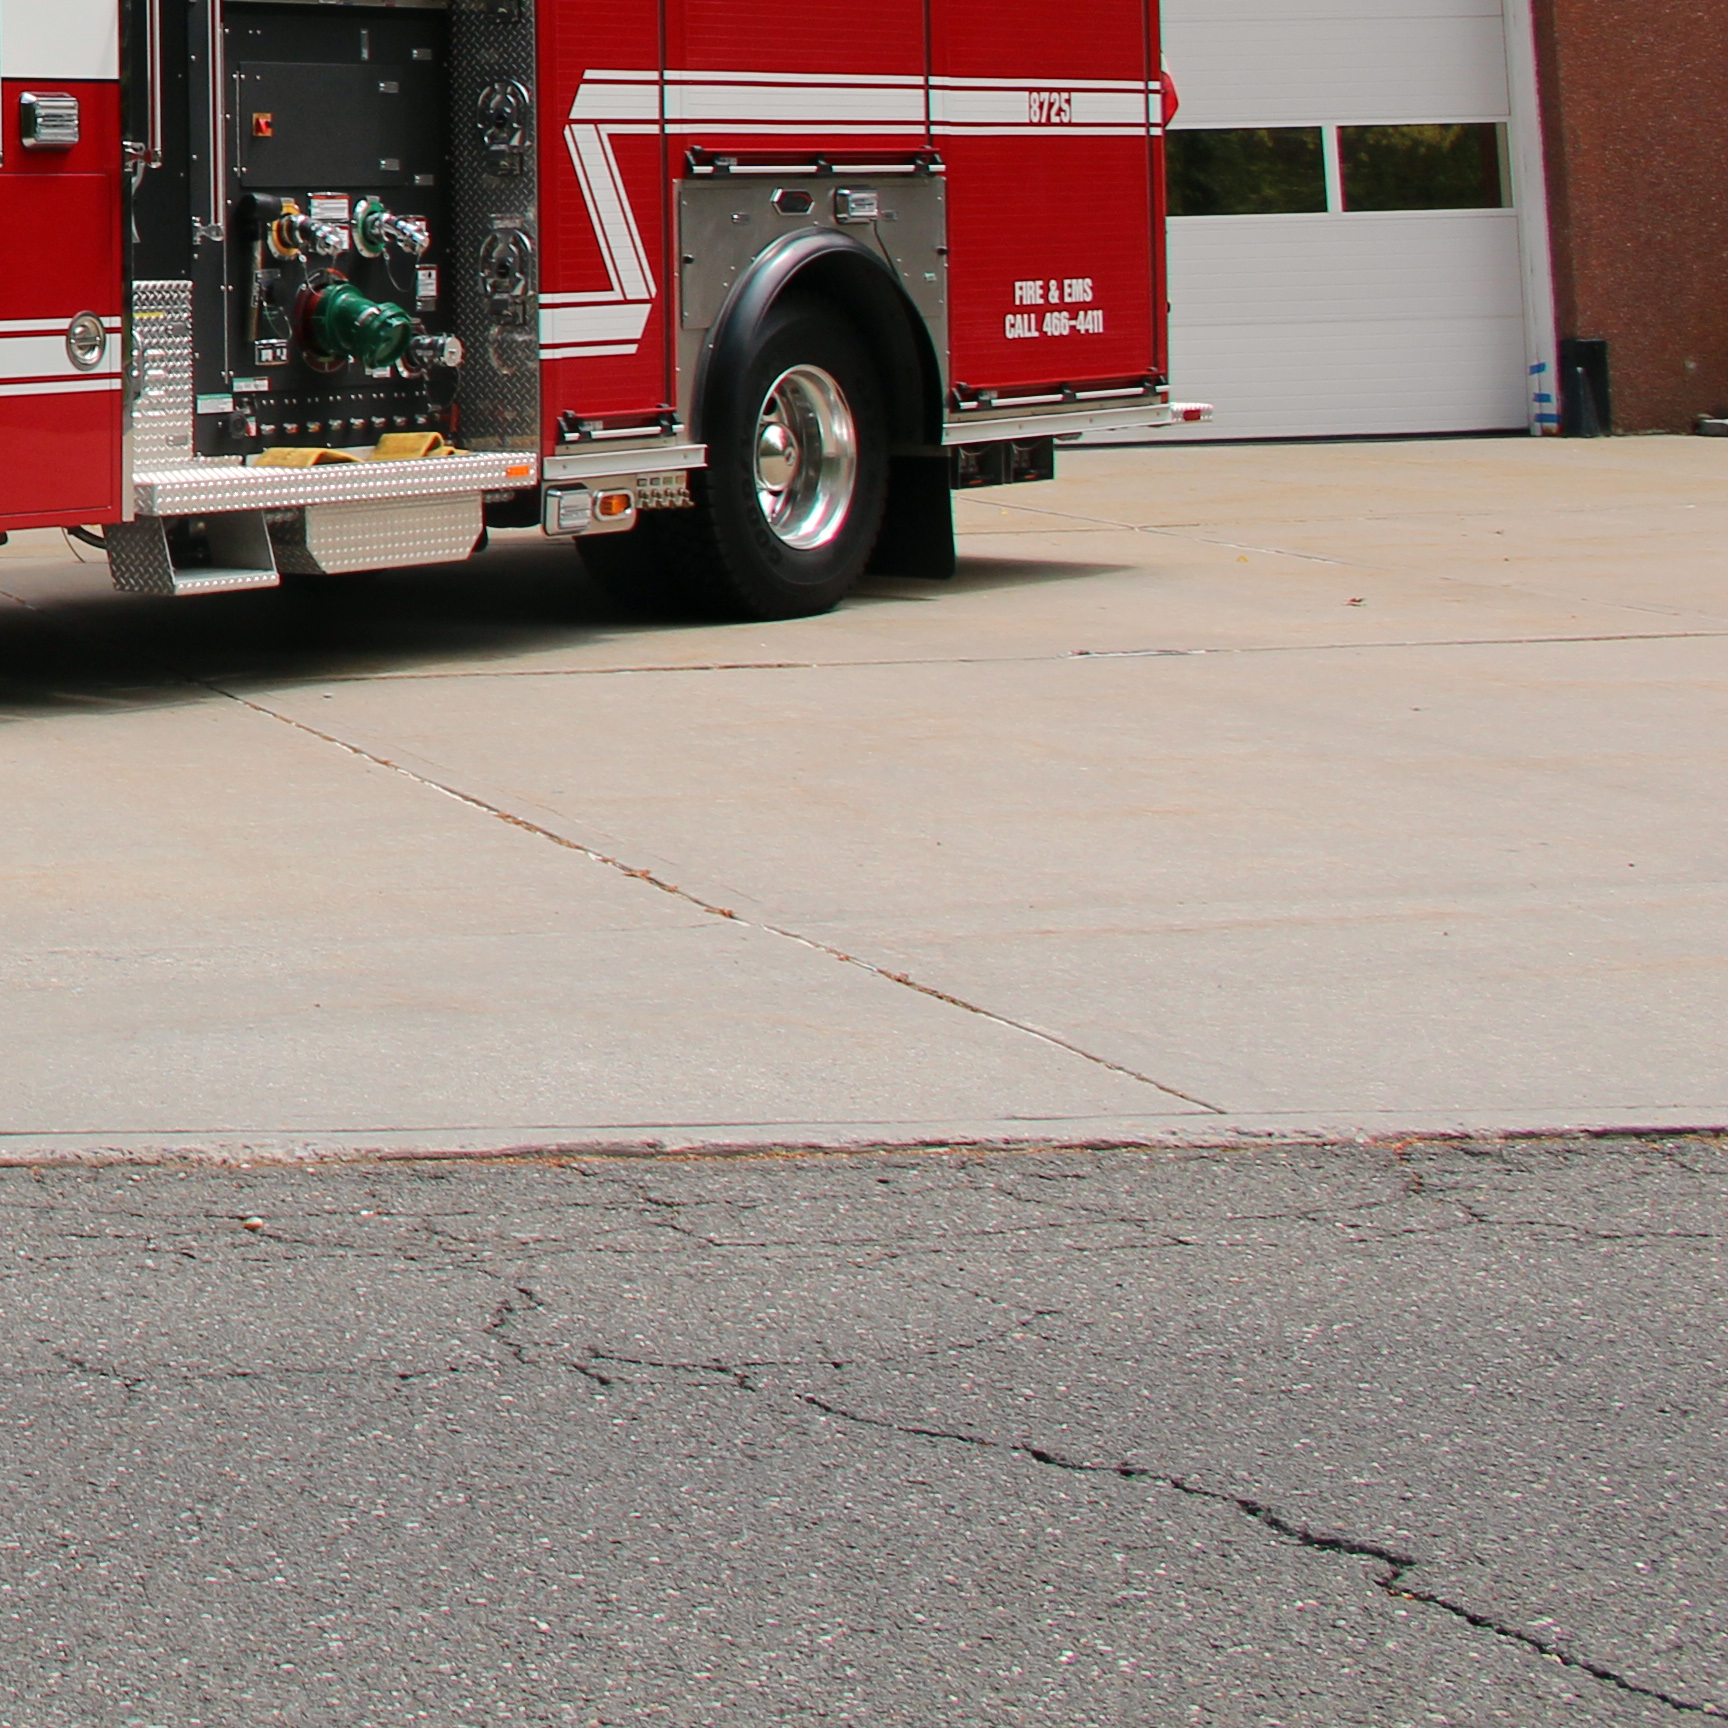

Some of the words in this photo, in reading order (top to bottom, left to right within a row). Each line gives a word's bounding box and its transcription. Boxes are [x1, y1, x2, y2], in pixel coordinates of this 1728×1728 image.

[1029, 91, 1071, 123] 8725
[1013, 279, 1045, 305] FIRE
[1048, 279, 1060, 304] &
[1063, 277, 1093, 303] EMS
[1004, 313, 1040, 339] CALL
[1042, 309, 1104, 337] 466-4411
